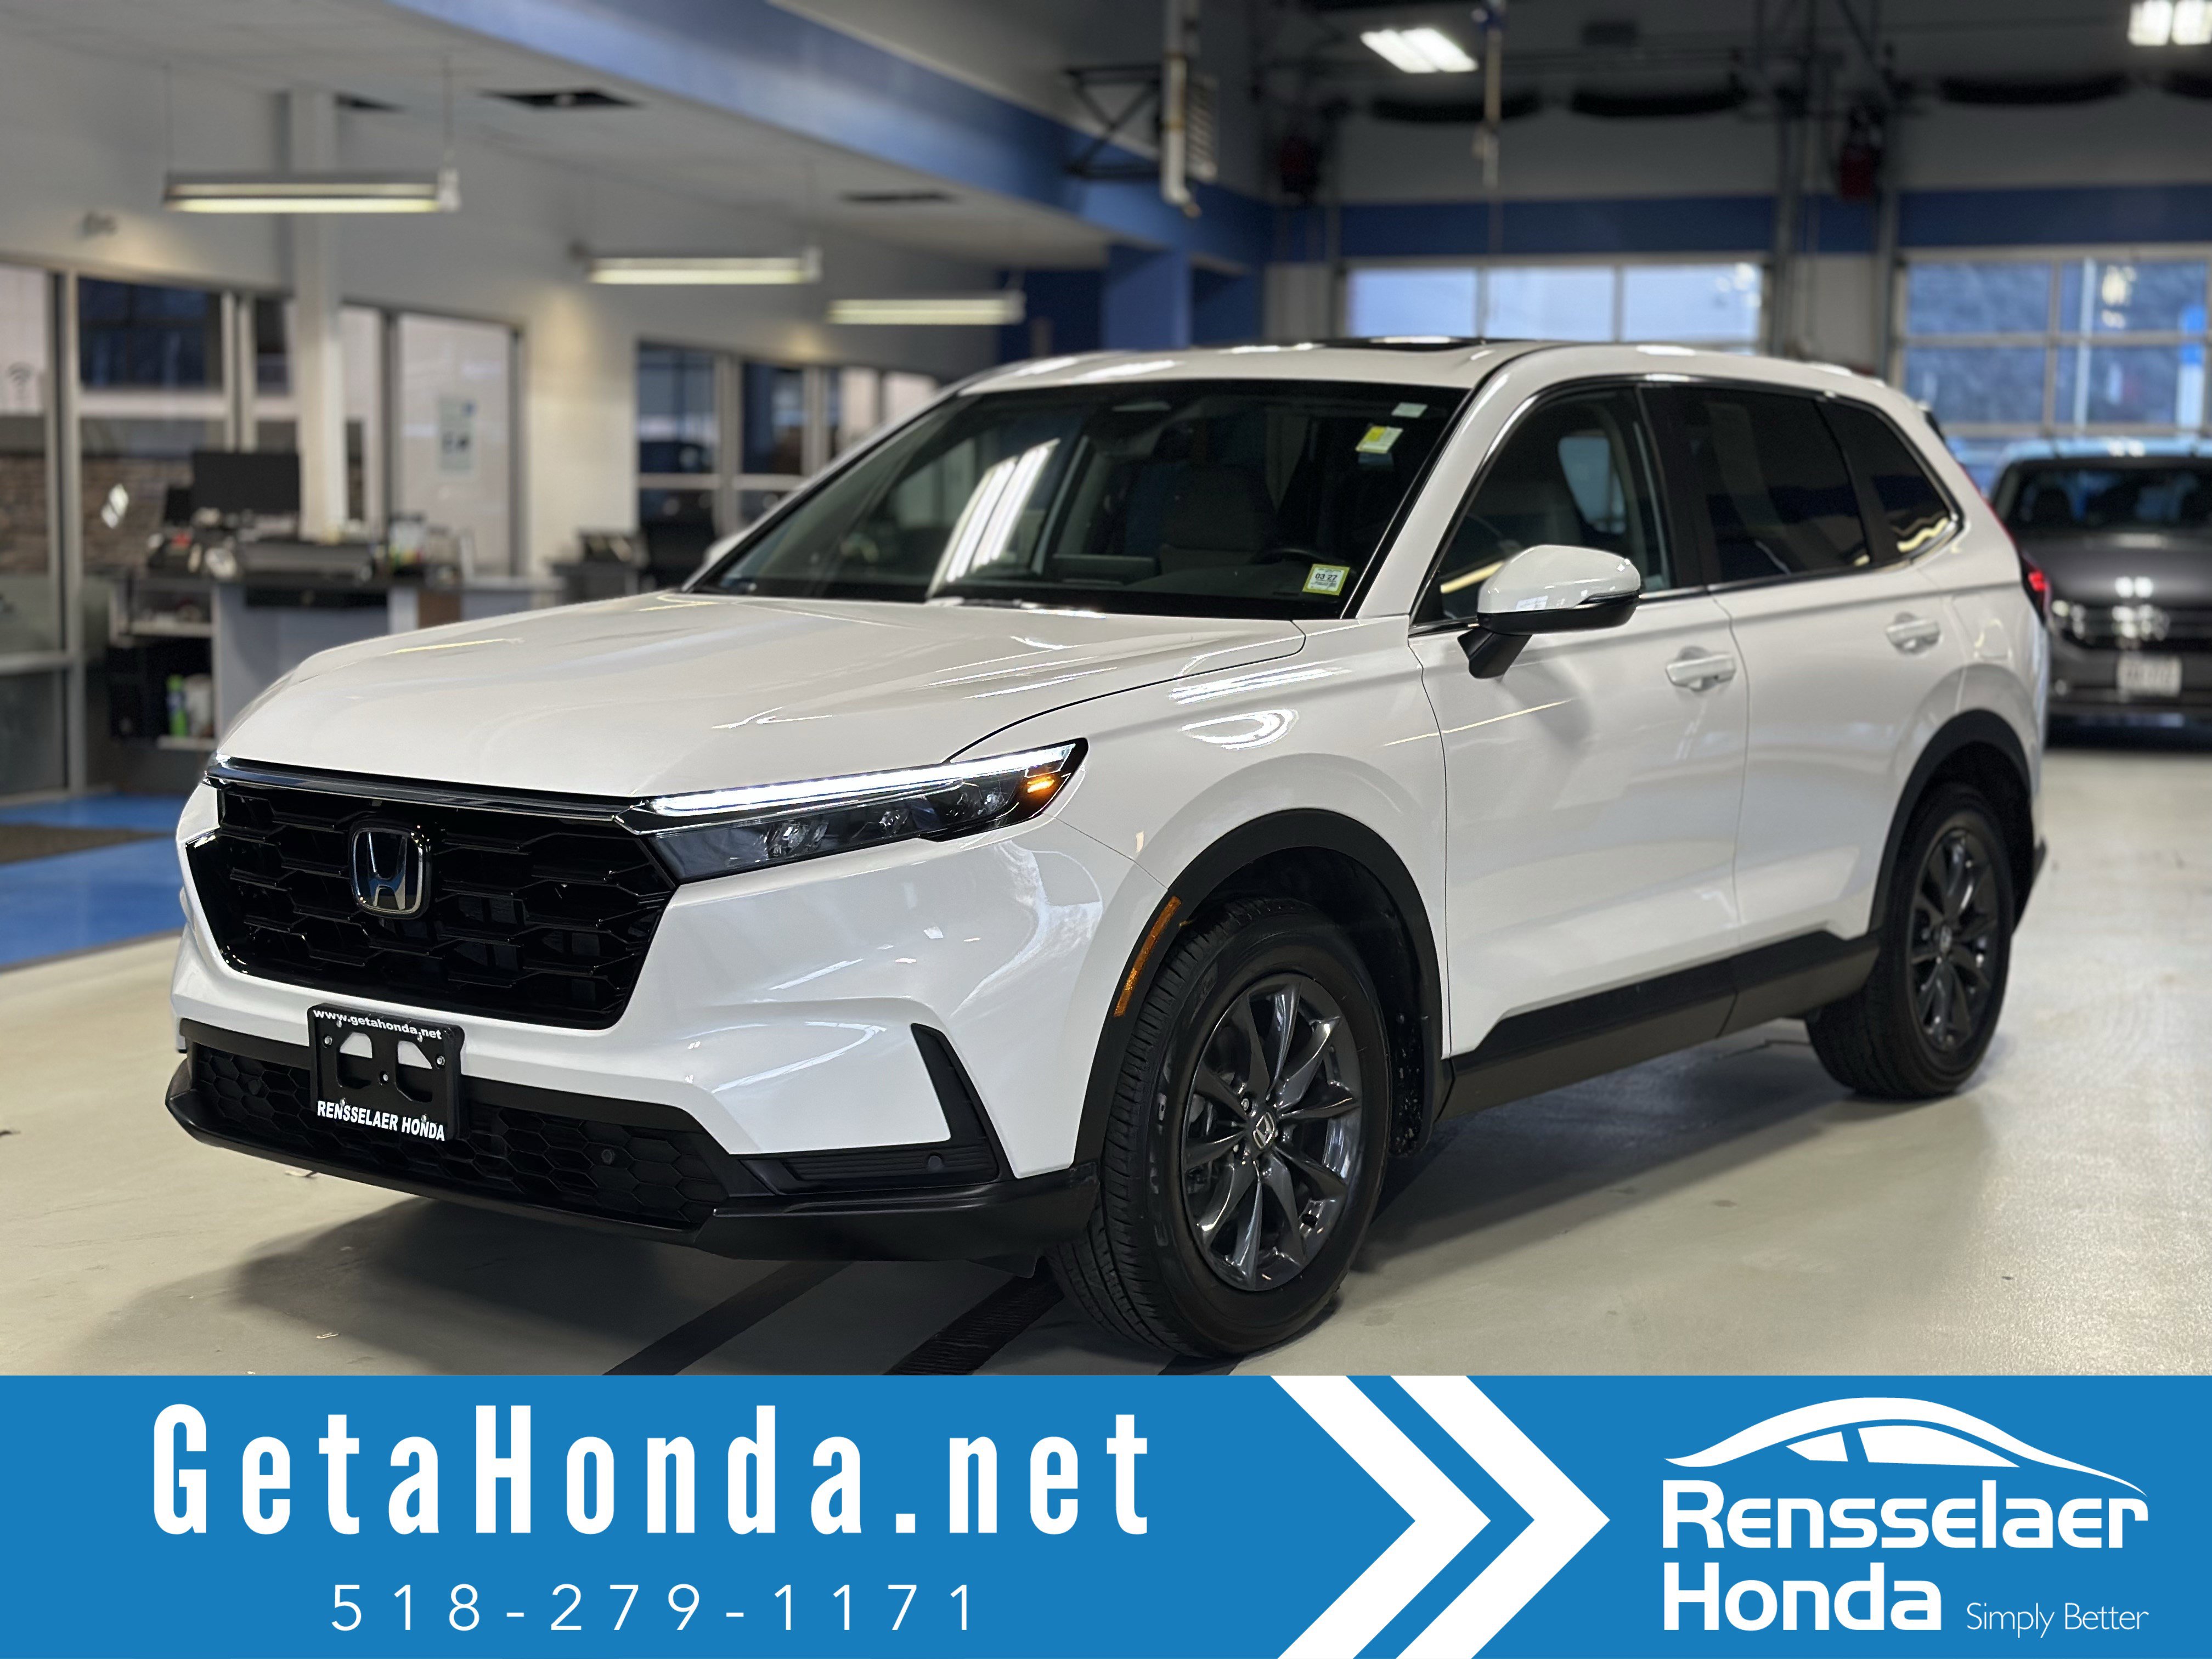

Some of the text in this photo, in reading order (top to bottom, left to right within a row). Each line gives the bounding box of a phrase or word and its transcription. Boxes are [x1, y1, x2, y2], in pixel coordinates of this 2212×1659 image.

[313, 1009, 442, 1040] www.getahonda.net
[317, 1100, 445, 1141] RENSSELAER HONDA
